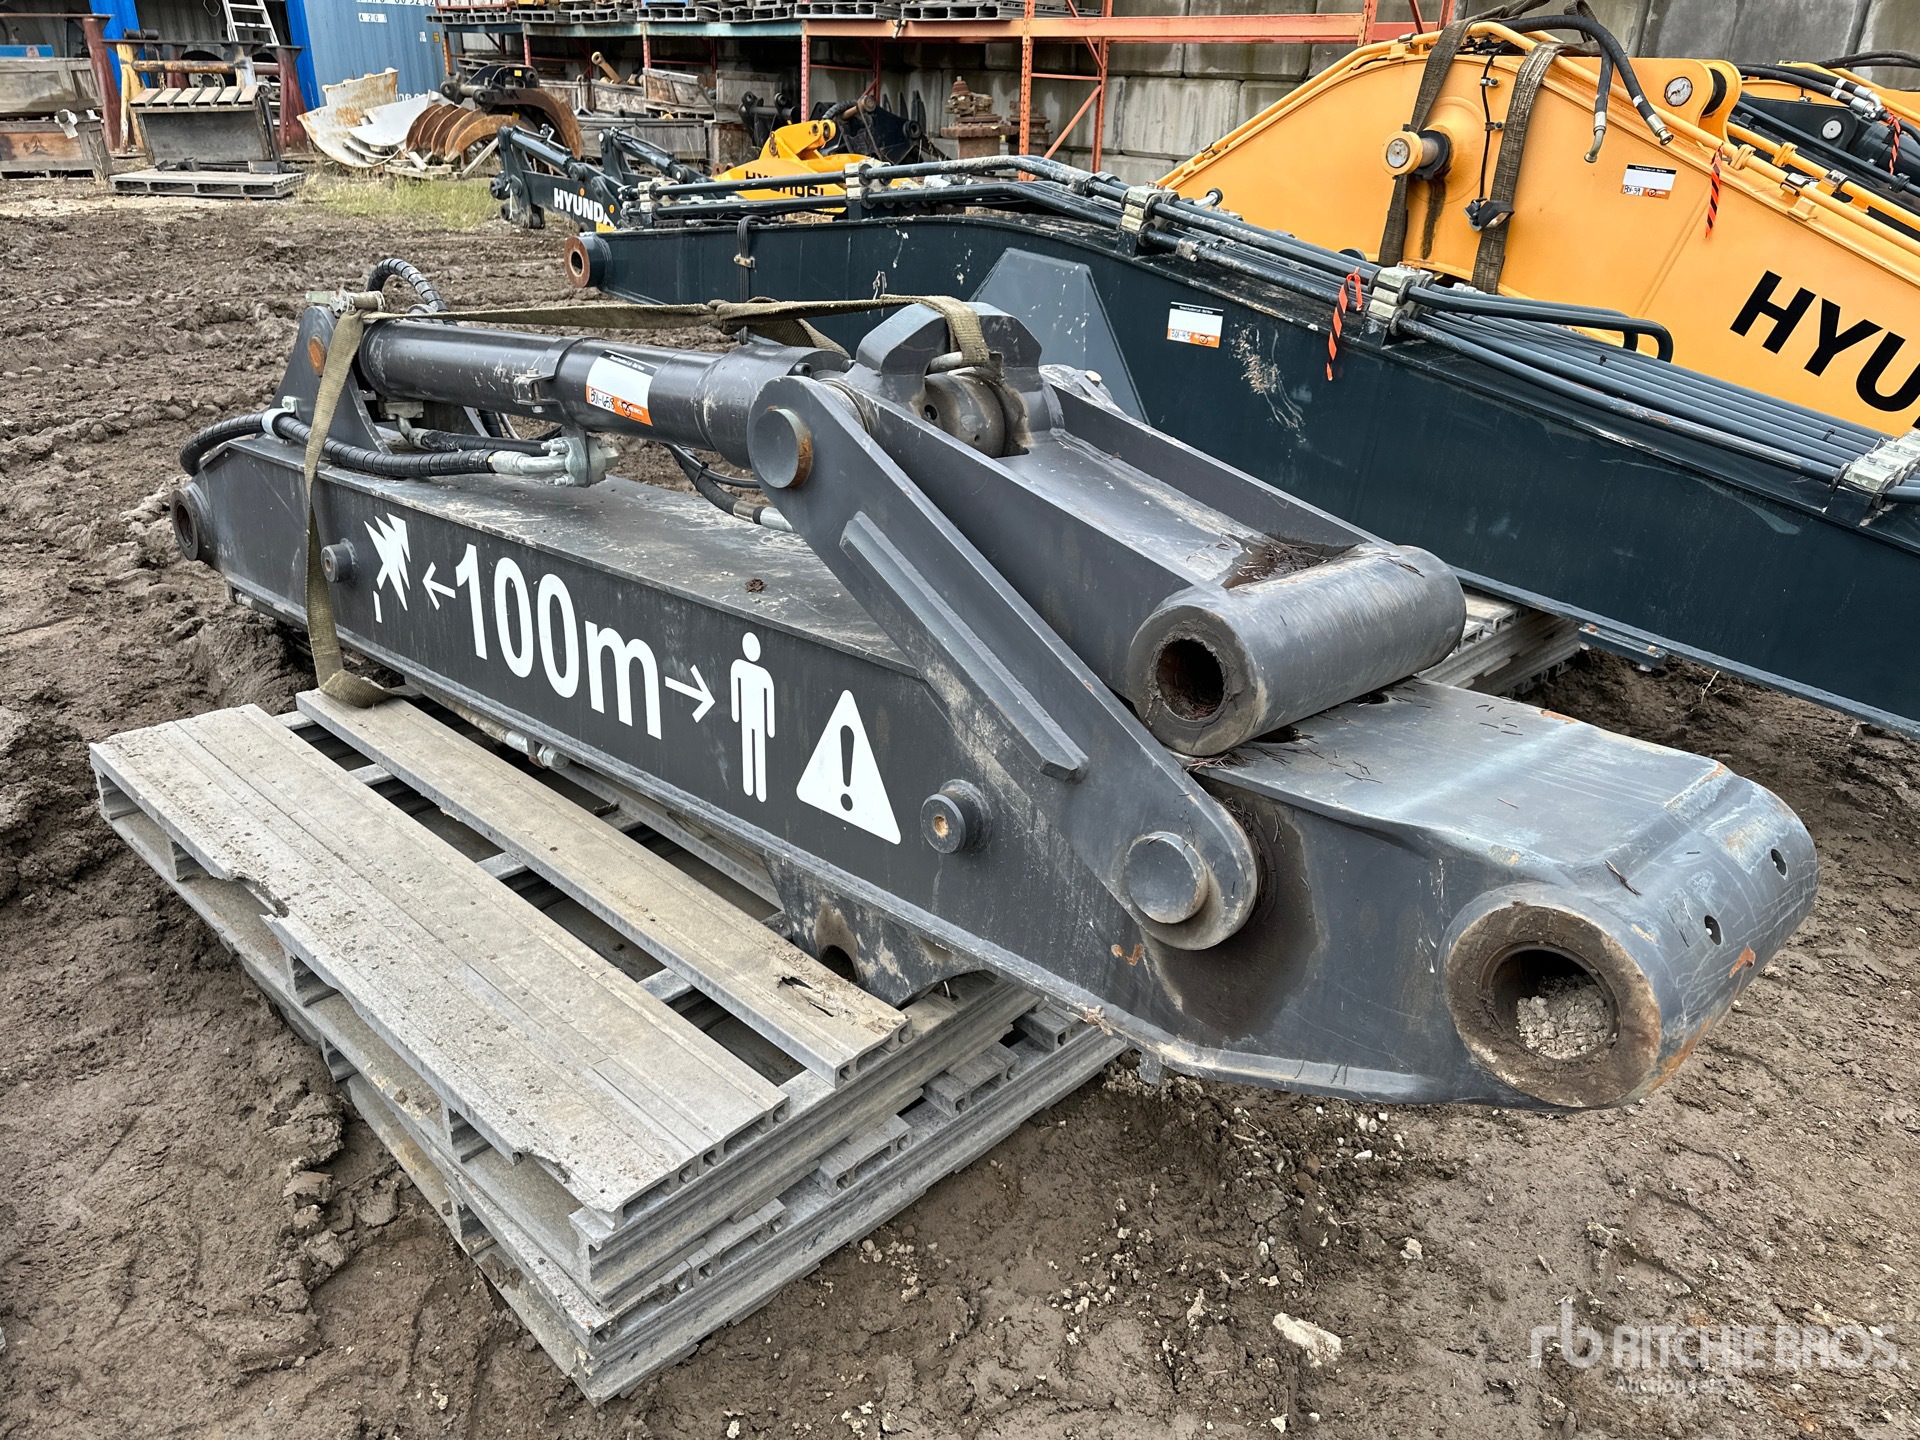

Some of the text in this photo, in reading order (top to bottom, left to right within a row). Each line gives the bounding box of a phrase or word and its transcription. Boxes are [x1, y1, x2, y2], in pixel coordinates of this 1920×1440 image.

[553, 187, 617, 232] HYUNDA
[1729, 270, 1920, 431] HYU
[455, 543, 662, 740] 100m
